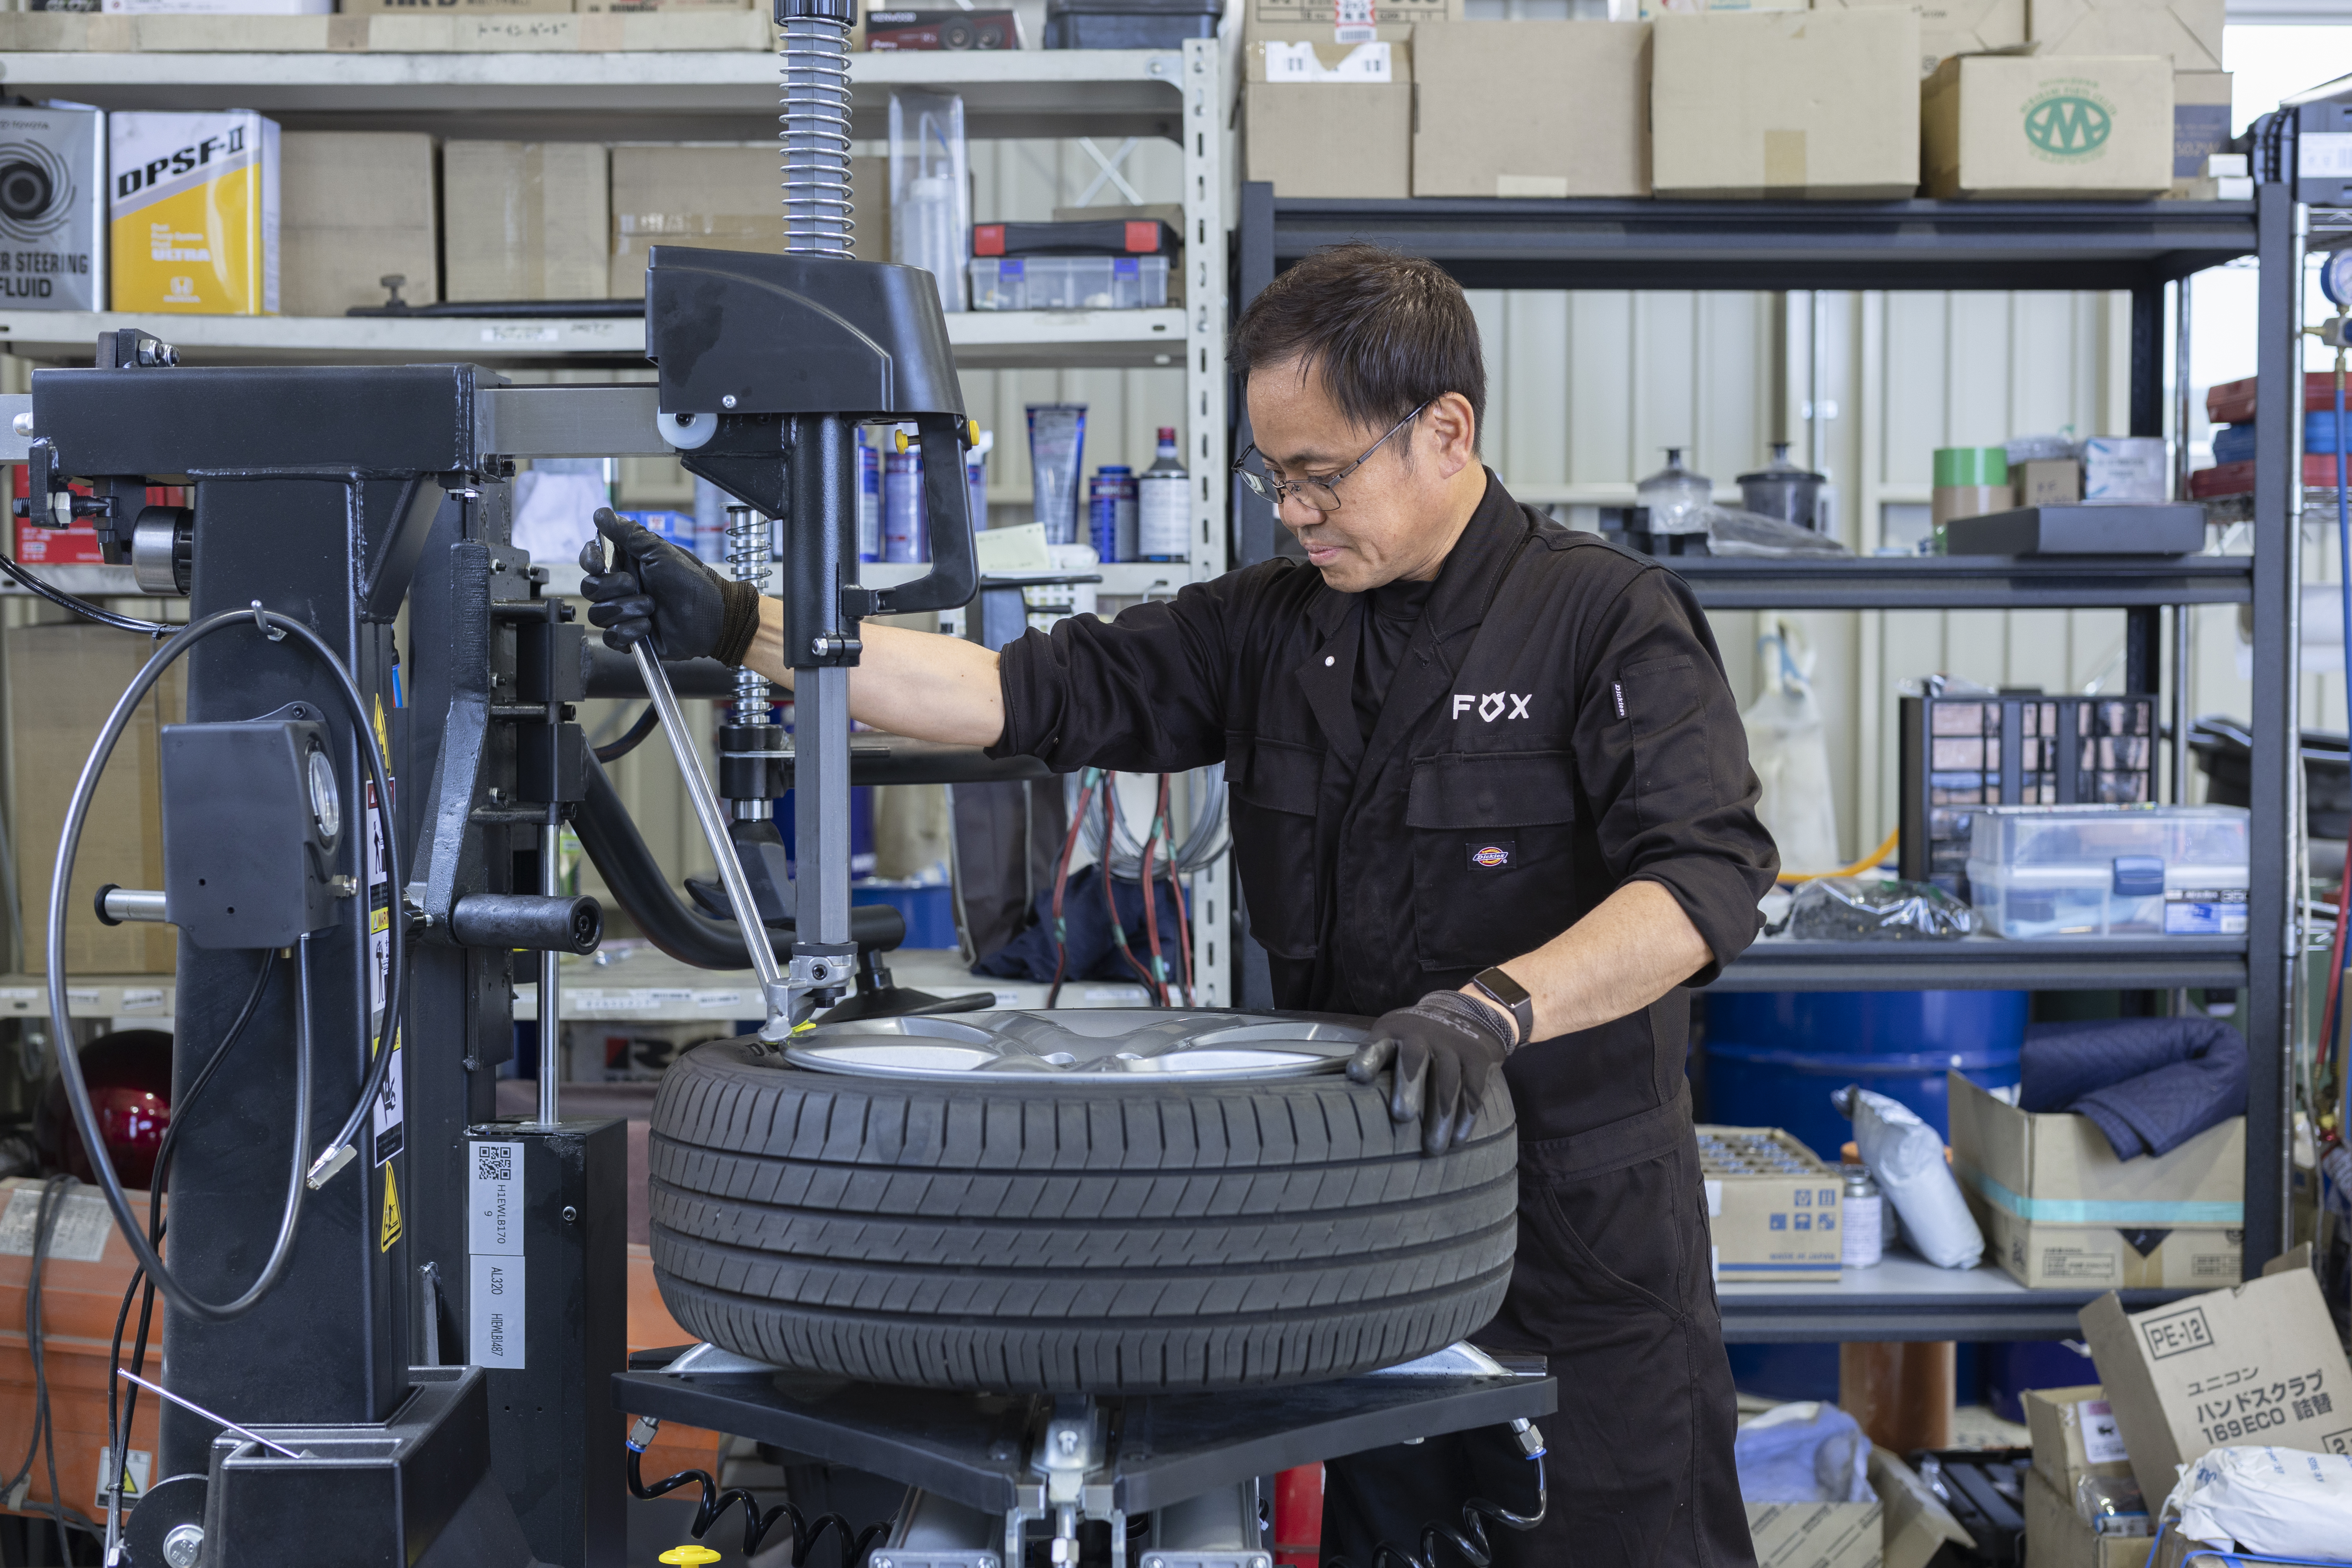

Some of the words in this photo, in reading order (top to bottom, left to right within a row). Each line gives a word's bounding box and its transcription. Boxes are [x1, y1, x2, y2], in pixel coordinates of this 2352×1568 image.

[16, 252, 88, 275] STEERING
[1453, 691, 1532, 722] FOX
[1615, 684, 1624, 713] Dickies
[497, 1185, 506, 1244] H1EWLB170
[491, 1267, 503, 1295] AL320
[491, 1314, 503, 1357] H1EWLB1487
[2150, 1318, 2204, 1351] PE-12
[2188, 1367, 2258, 1397] ユニコン
[2197, 1368, 2323, 1423] ハンドスクラブ
[2203, 1408, 2286, 1444] 169ECO
[2292, 1392, 2333, 1421] 詰替
